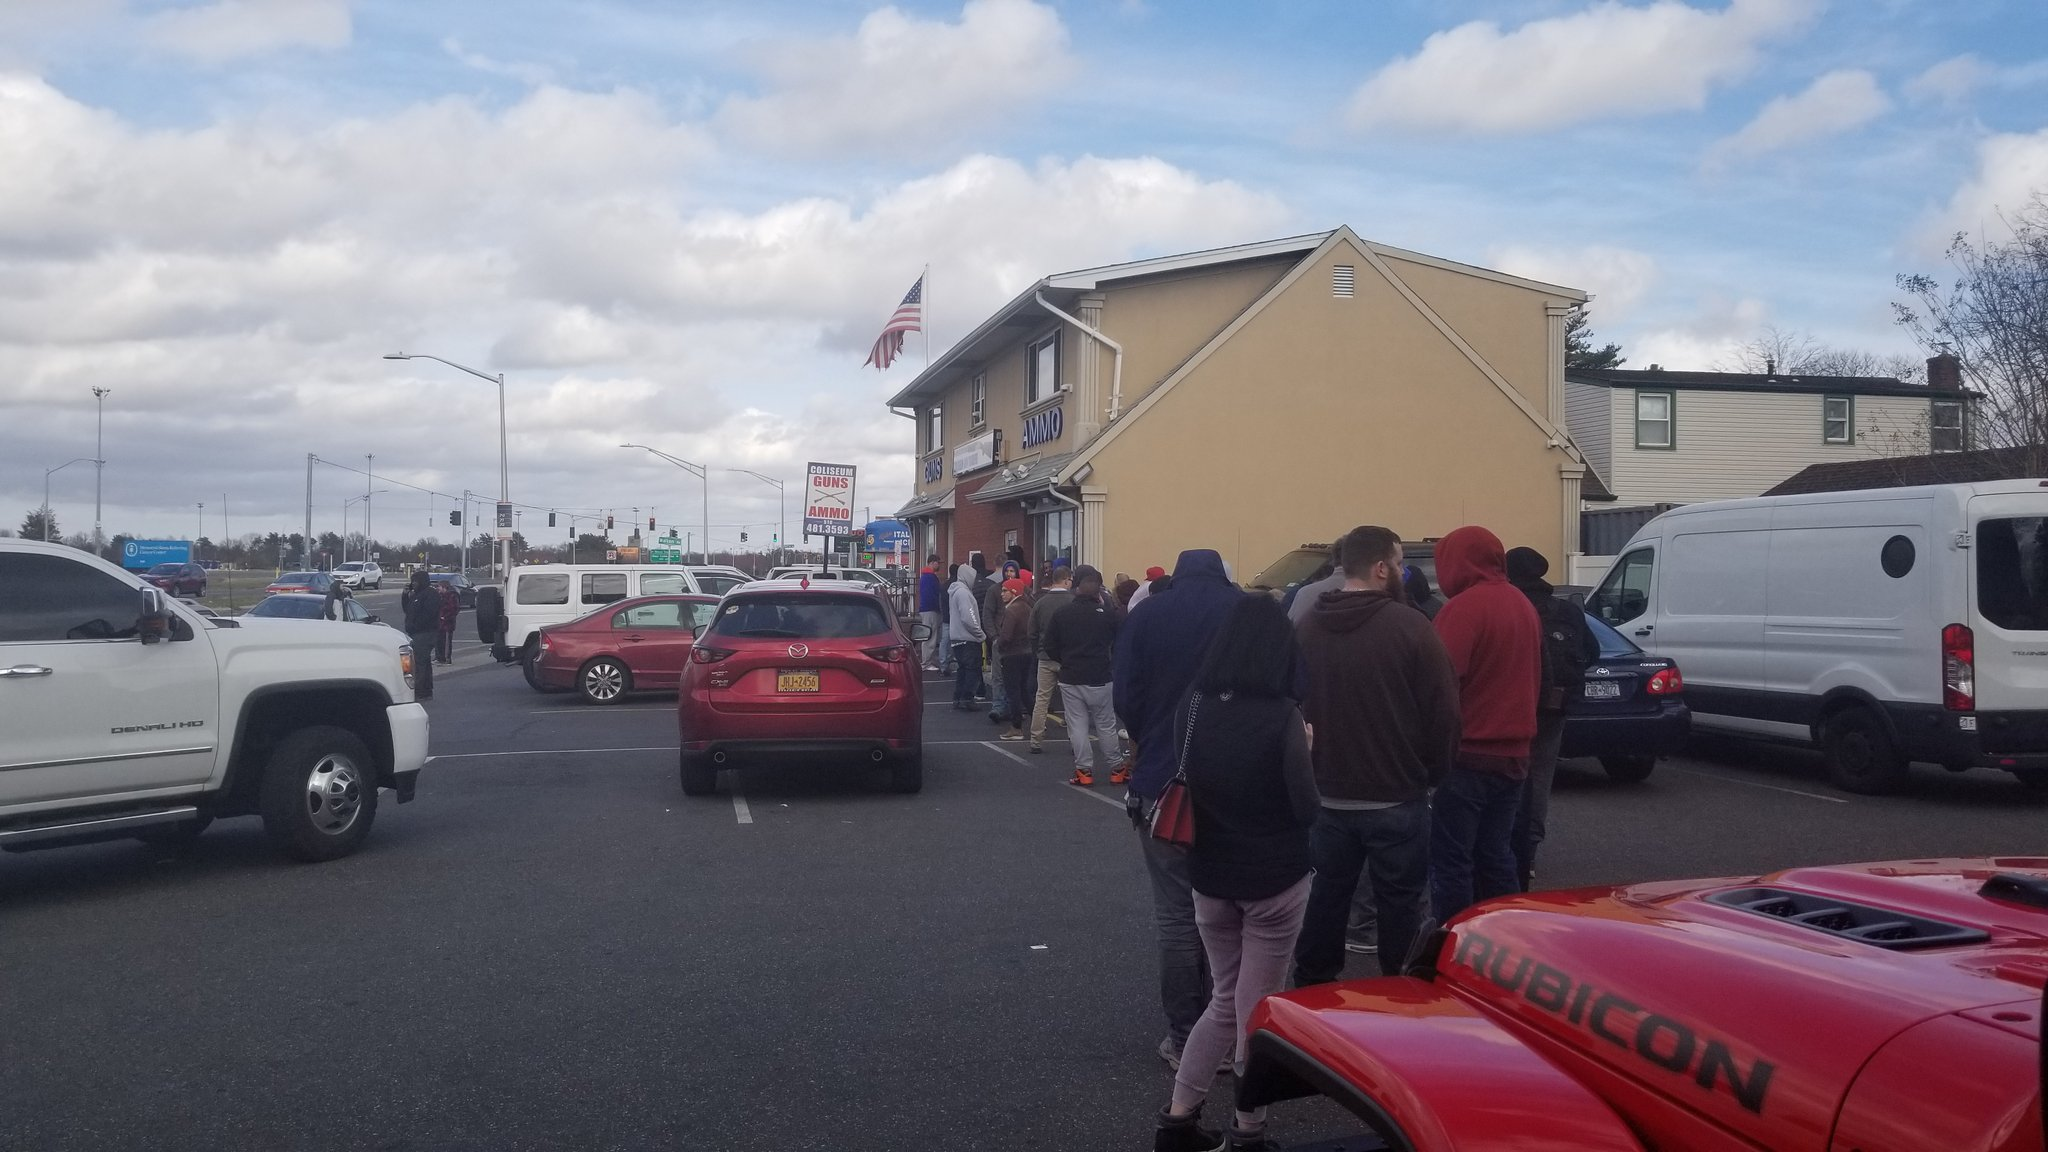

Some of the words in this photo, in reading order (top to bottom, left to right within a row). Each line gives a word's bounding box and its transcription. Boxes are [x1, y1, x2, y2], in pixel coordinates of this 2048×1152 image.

[1022, 406, 1063, 449] AMMO
[810, 465, 853, 477] COLISEUM
[813, 475, 849, 489] GUNS
[808, 505, 850, 520] AMMO
[806, 523, 849, 535] 481.3593
[111, 722, 176, 734] DENALI
[179, 720, 204, 728] HD
[1455, 932, 1775, 1115] RUBICON
